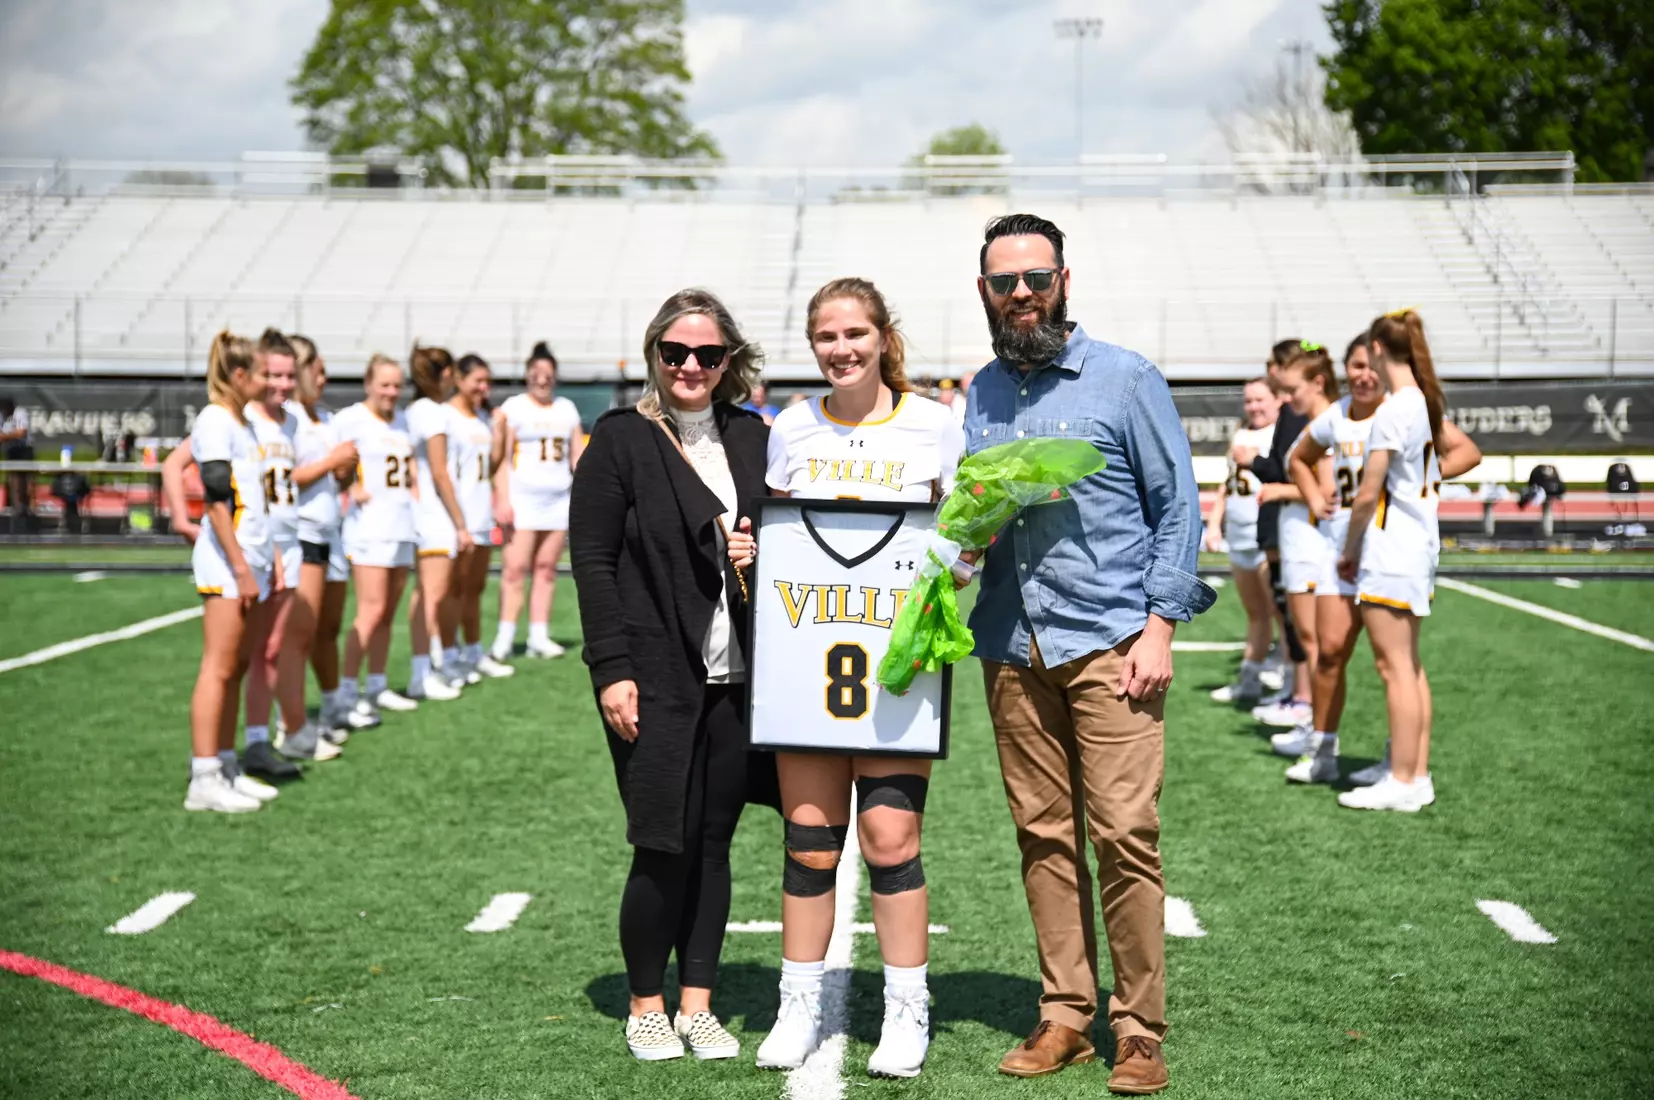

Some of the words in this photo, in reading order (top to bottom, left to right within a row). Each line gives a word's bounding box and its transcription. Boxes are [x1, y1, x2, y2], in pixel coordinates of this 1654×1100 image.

[540, 436, 564, 462] 15
[806, 457, 906, 493] VILLE
[824, 641, 871, 721] 8
